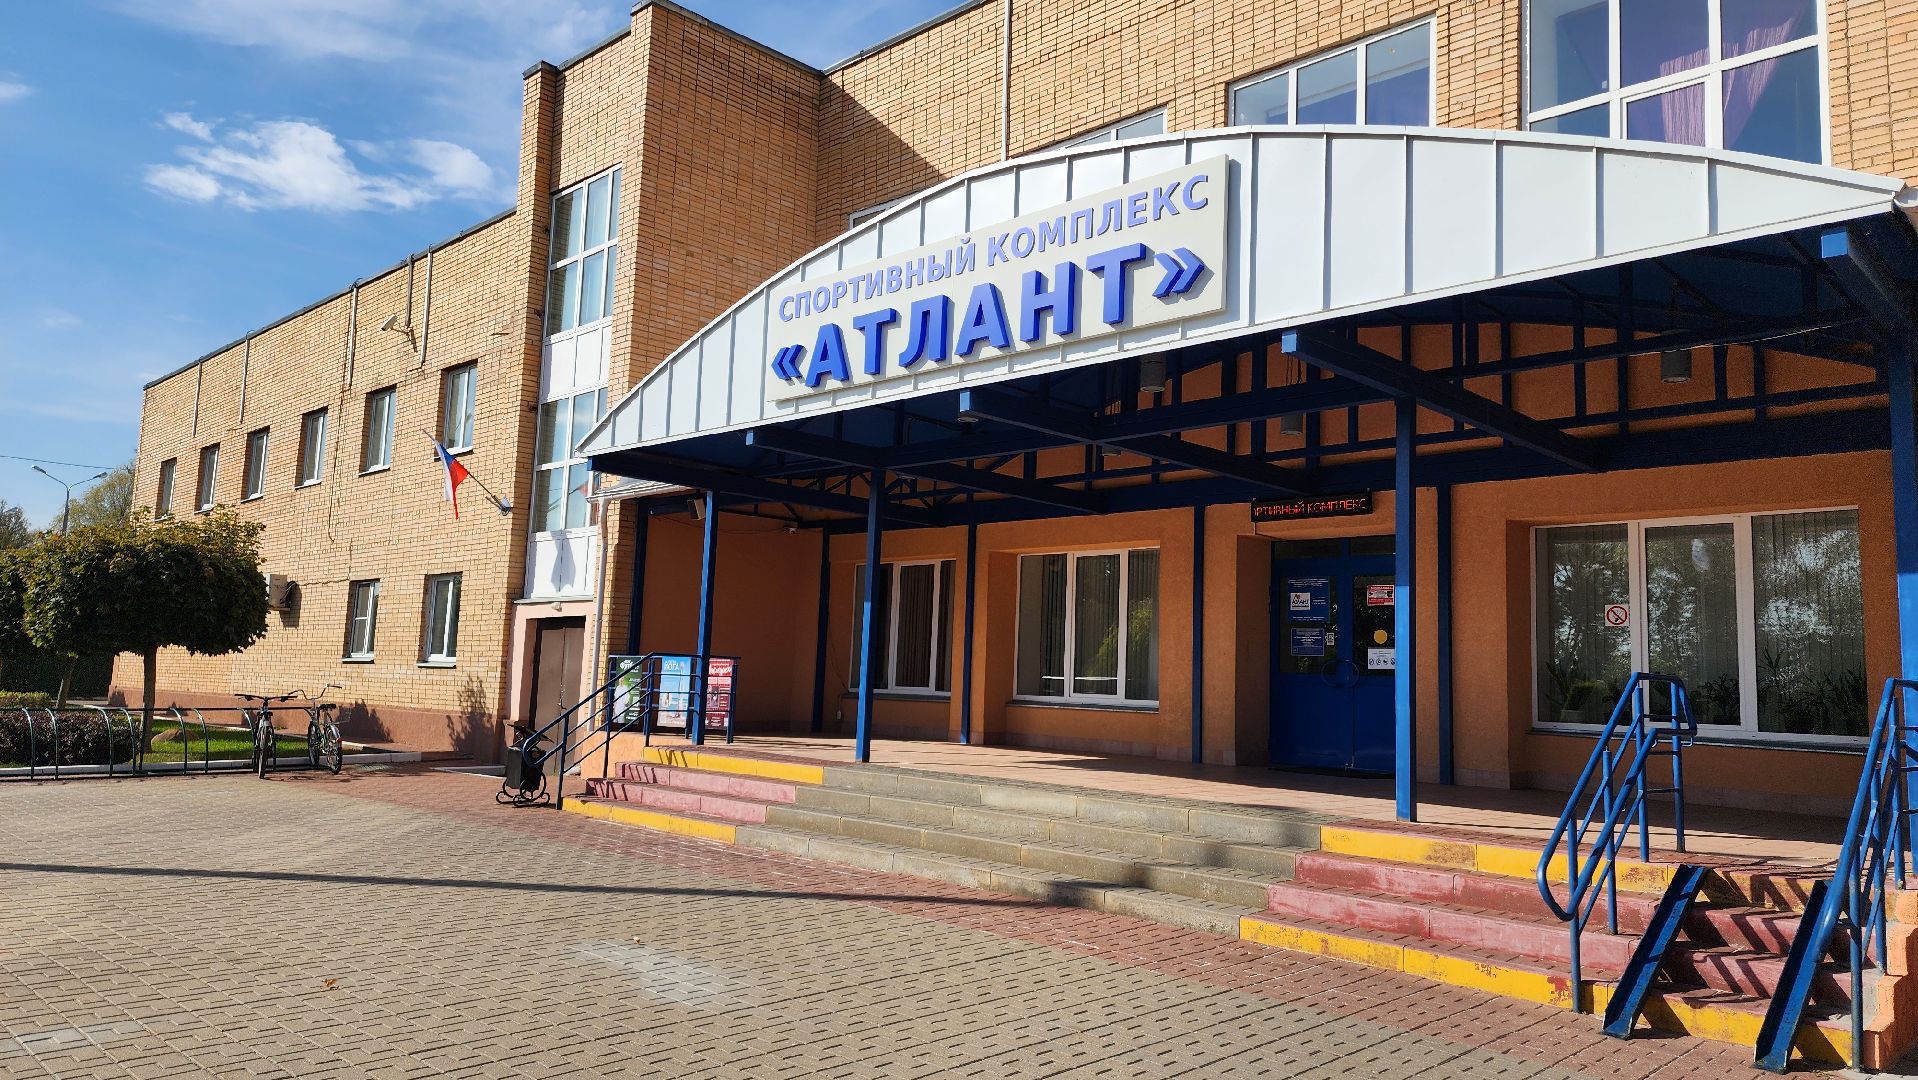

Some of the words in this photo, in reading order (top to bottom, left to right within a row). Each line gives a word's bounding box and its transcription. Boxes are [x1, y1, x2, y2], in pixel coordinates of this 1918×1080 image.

[771, 243, 1206, 388] «АТЛАНТ»
[778, 237, 976, 323] СПОРТИВНЫЙ
[987, 174, 1209, 267] КОМПЛЕКС
[1307, 498, 1367, 514] КОМПЛЕКС
